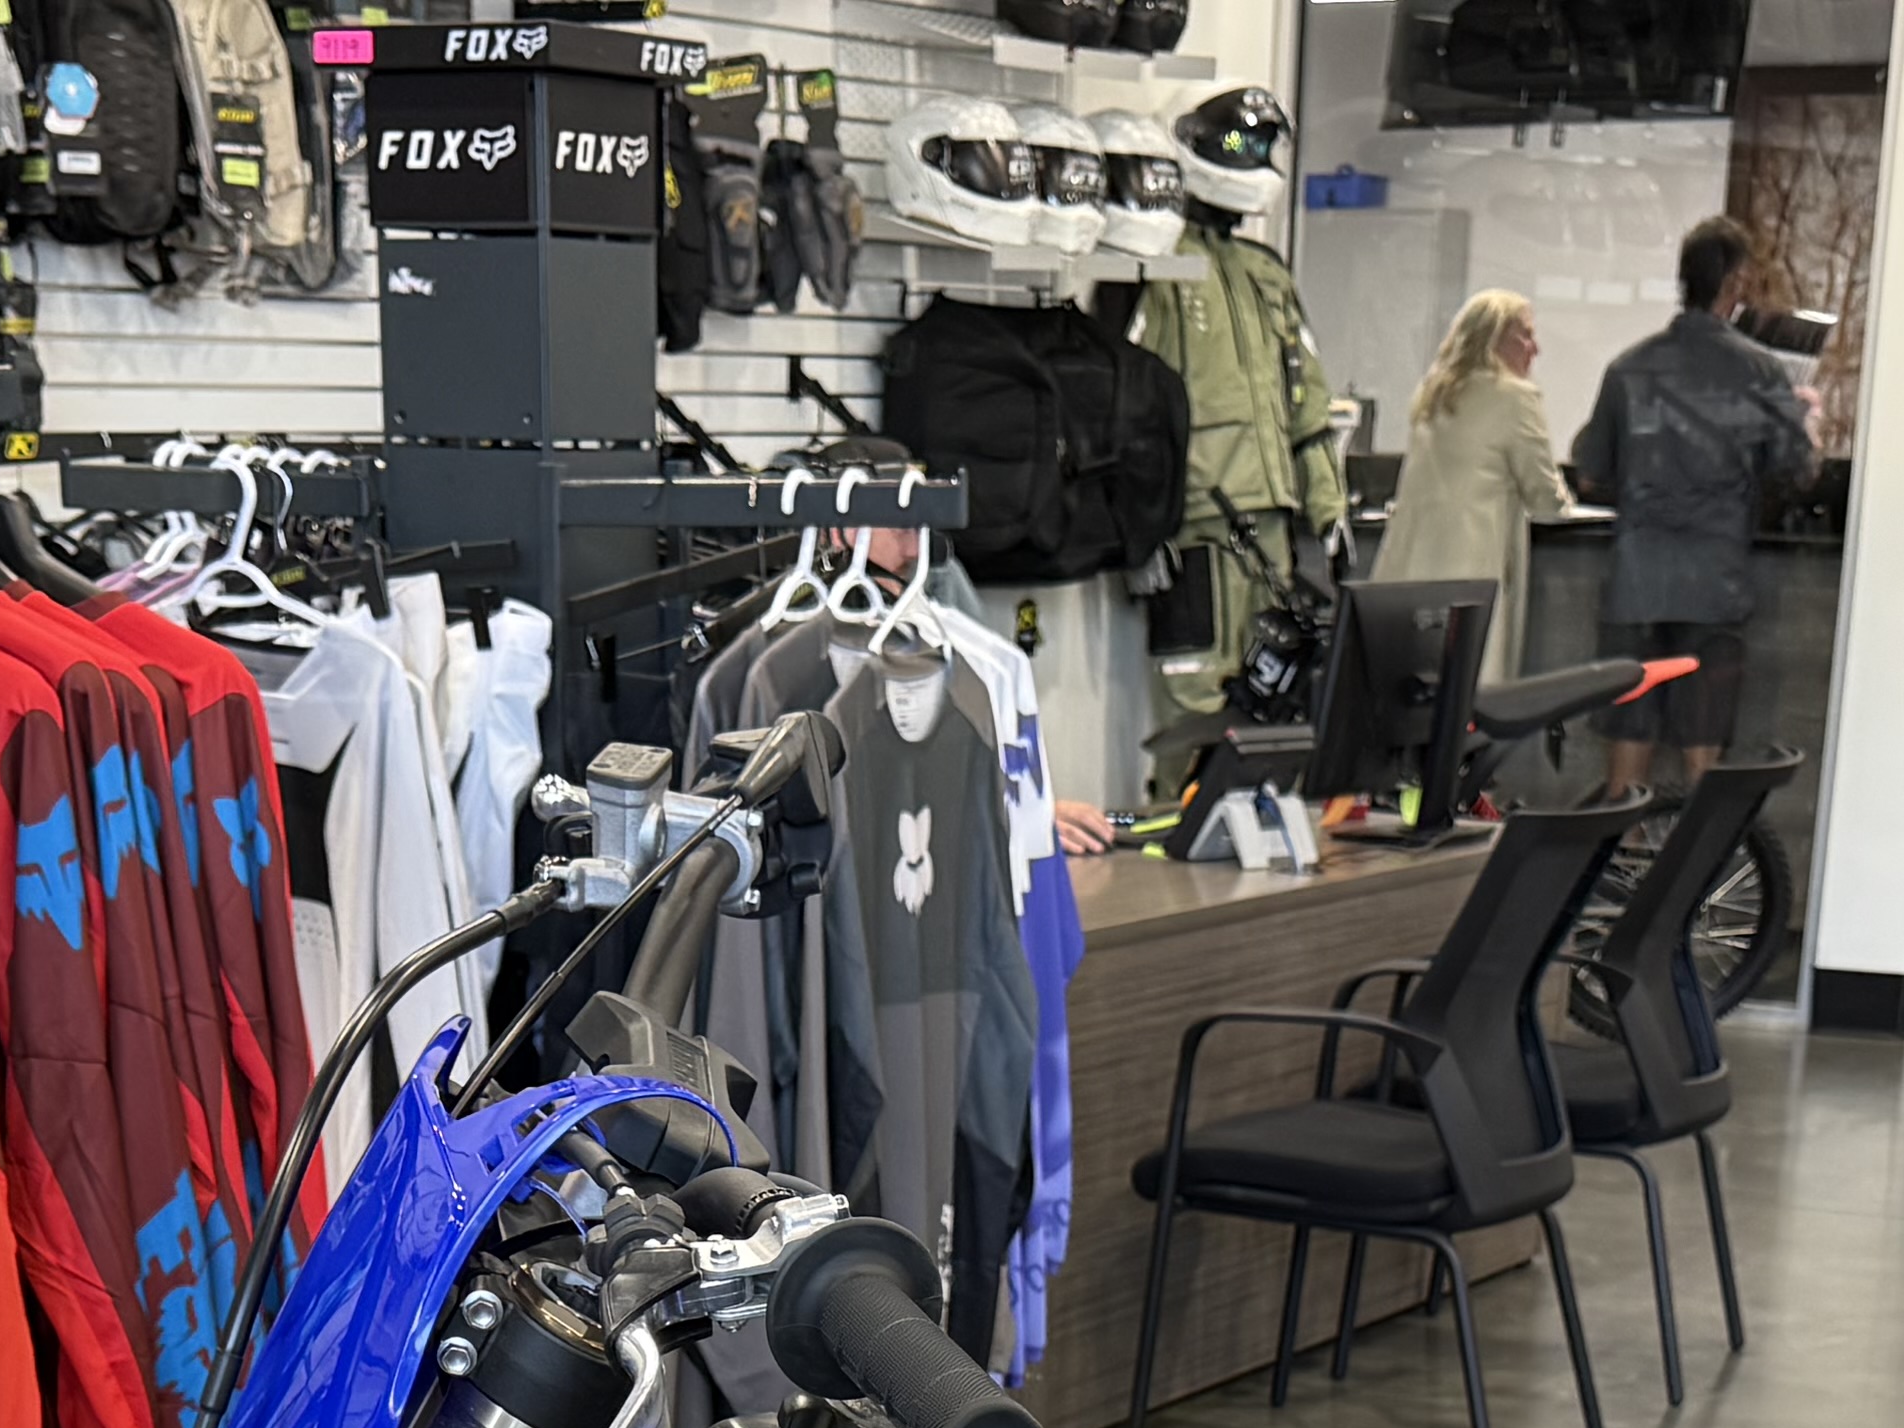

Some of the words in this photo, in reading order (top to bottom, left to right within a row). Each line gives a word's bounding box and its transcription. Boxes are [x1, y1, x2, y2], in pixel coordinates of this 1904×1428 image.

[445, 30, 513, 61] FOX
[641, 41, 686, 75] FOX
[379, 130, 460, 170] FOX
[555, 130, 616, 174] FOX
